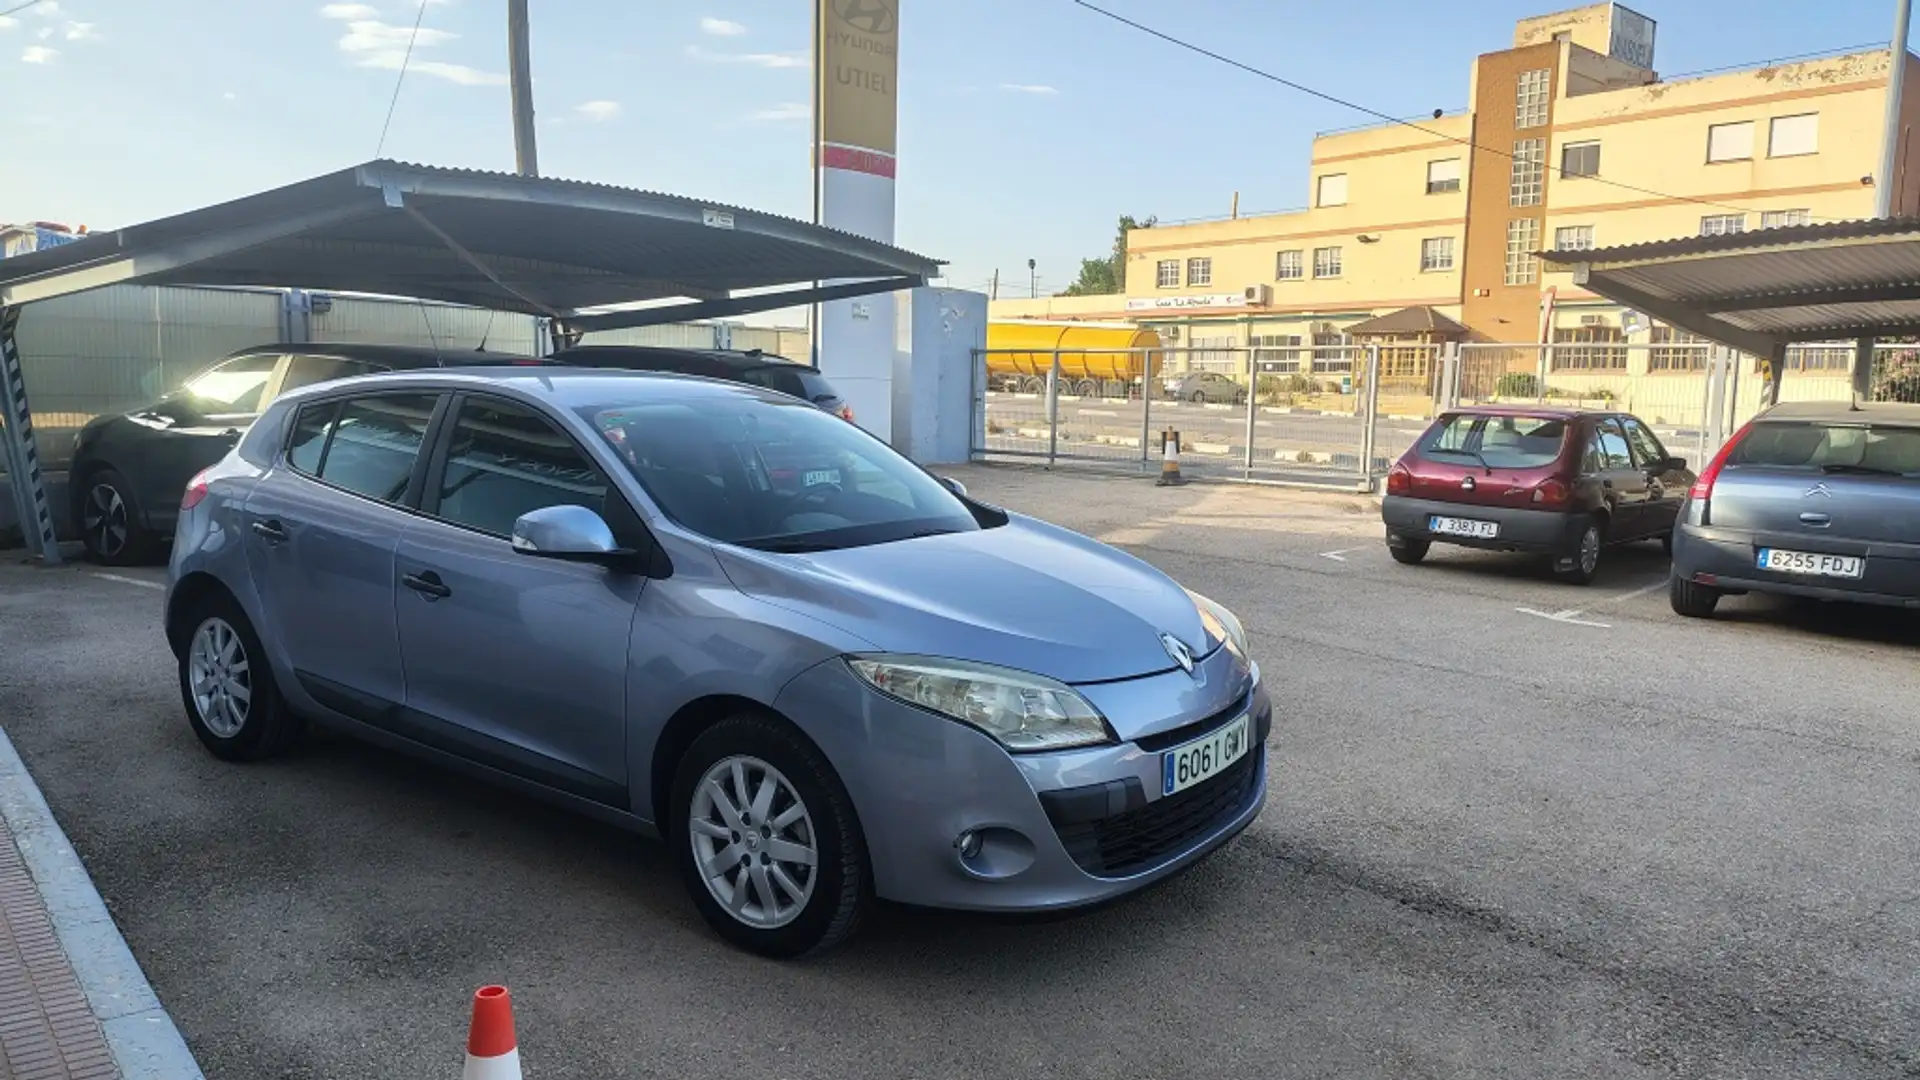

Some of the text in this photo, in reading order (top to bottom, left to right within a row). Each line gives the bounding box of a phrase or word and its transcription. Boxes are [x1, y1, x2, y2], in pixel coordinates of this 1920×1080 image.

[826, 30, 896, 58] HYUNDA
[836, 64, 888, 95] UTIEL
[1155, 299, 1171, 307] Casa
[1448, 519, 1476, 533] 3383
[1480, 523, 1494, 535] FL
[1772, 551, 1856, 573] 6255 FDJ
[1178, 739, 1219, 784] 6061
